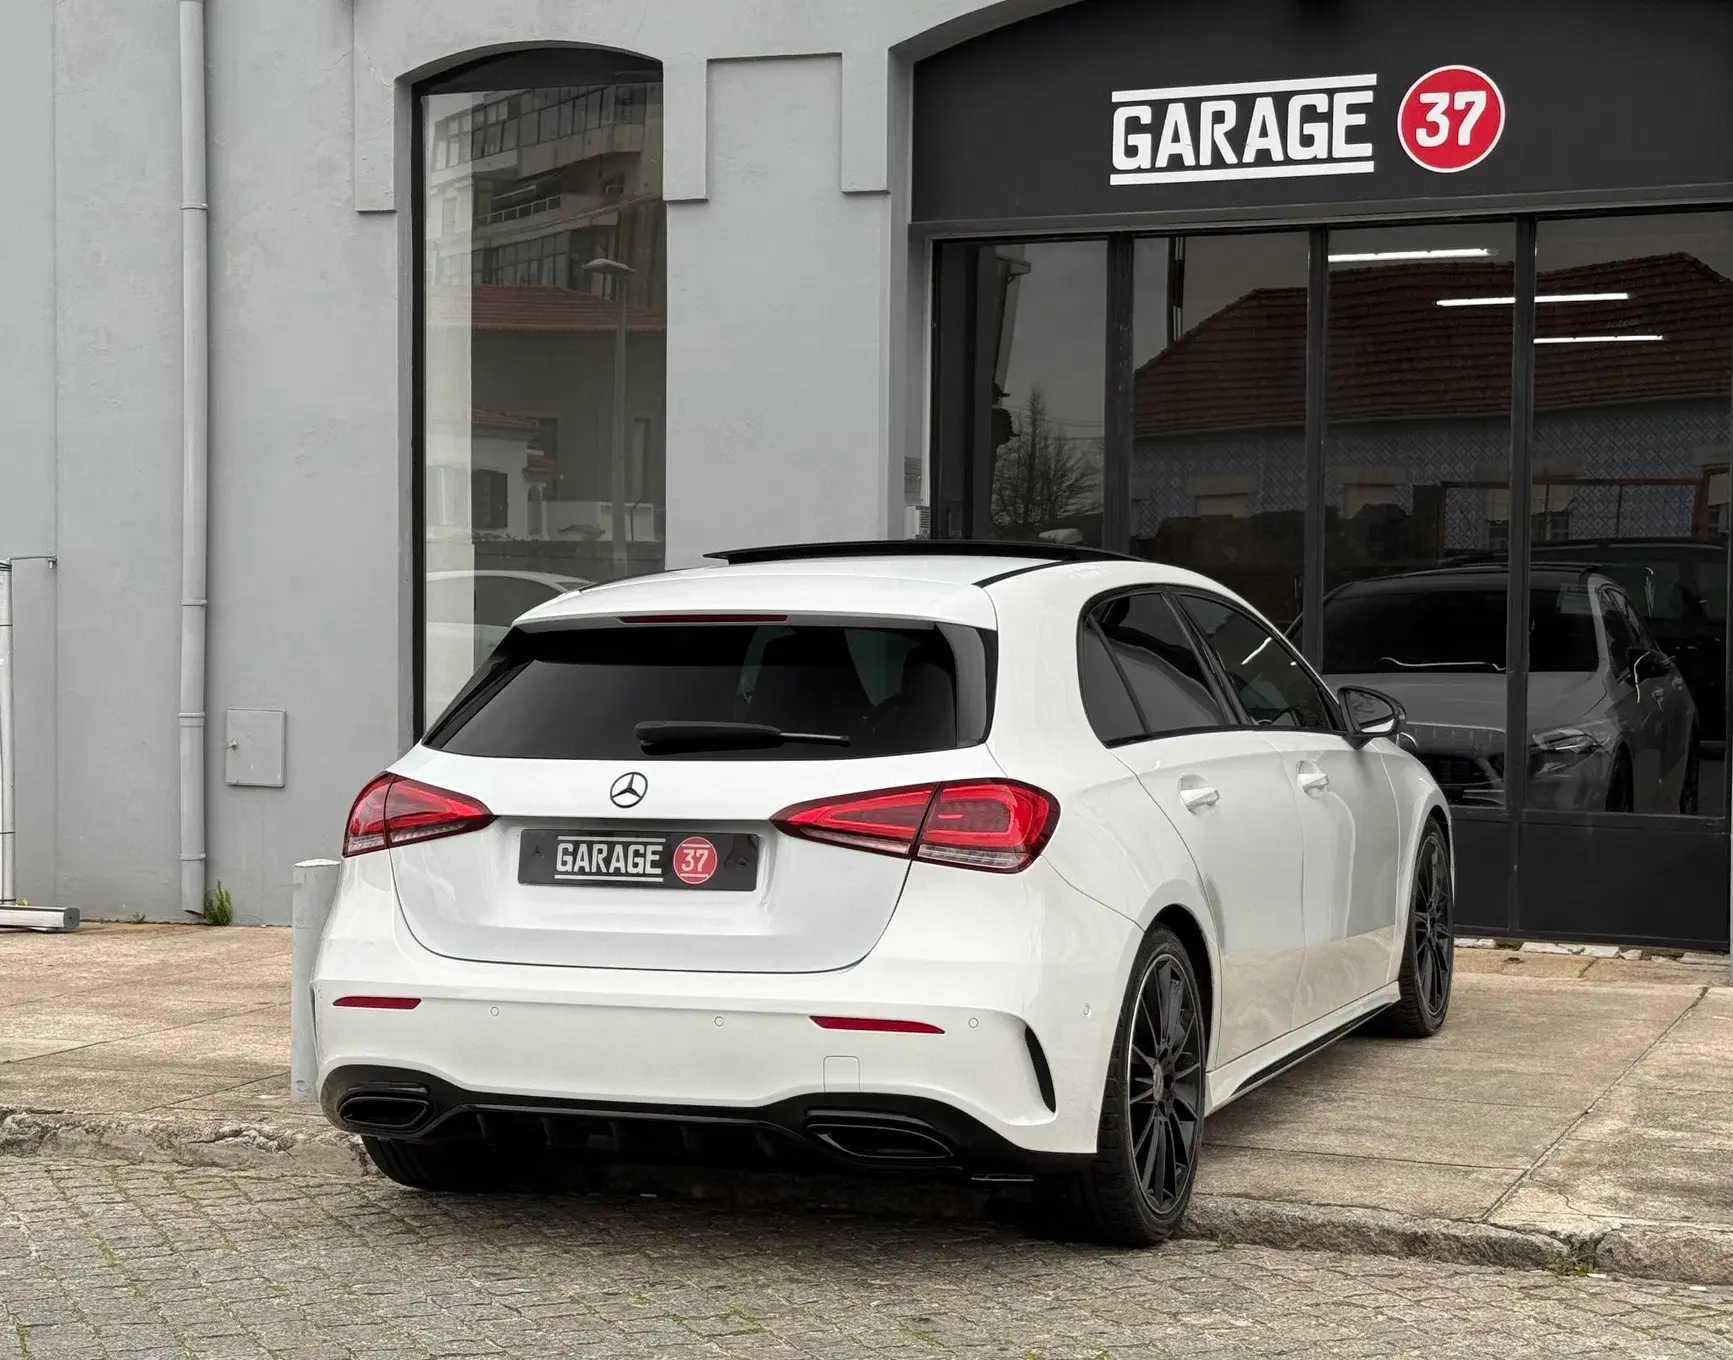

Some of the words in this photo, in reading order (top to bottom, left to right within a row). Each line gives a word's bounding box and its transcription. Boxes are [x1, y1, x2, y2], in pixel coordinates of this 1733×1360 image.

[1112, 91, 1374, 170] GARAGE
[1416, 91, 1487, 147] 37
[556, 843, 663, 874] GARAGE
[681, 849, 708, 872] 37
